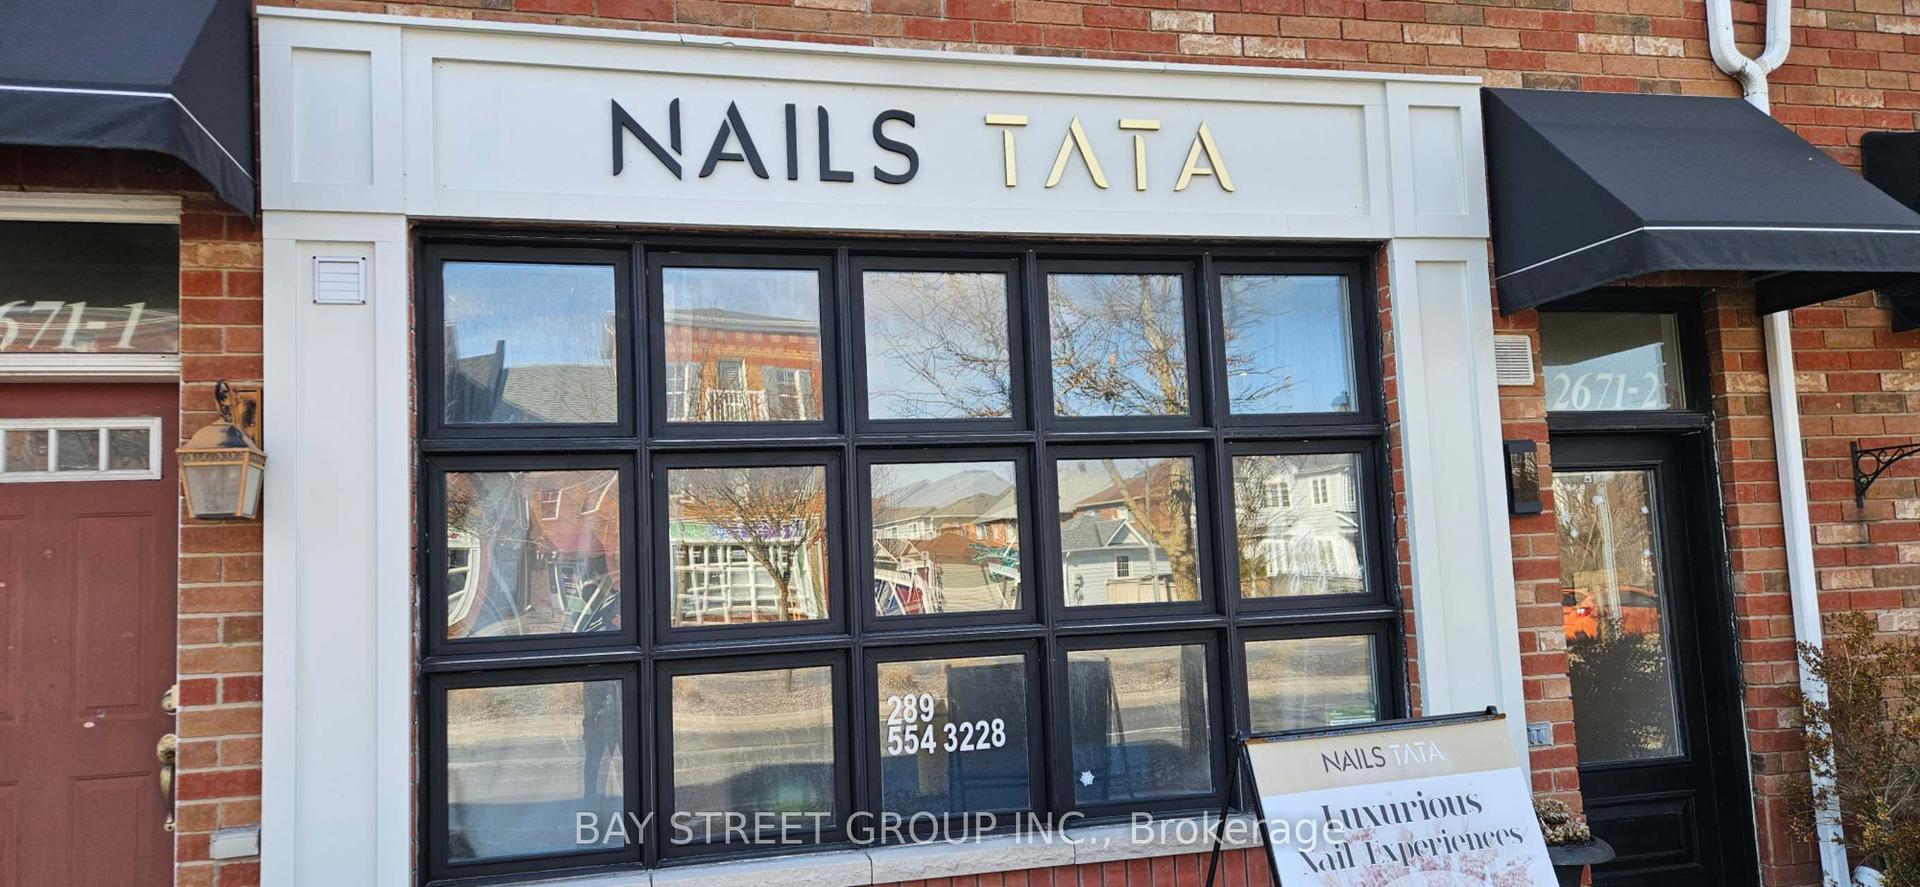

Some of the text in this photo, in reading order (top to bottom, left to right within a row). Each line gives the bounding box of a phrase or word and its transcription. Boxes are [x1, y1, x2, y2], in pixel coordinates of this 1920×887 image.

[611, 97, 1235, 193] NAILS TATA
[1552, 371, 1660, 411] 2671-2
[886, 693, 935, 726] 289
[887, 718, 1006, 756] 554 3228
[1320, 740, 1448, 773] NAILS TATA
[1320, 791, 1483, 832] Luxurious
[1299, 827, 1524, 875] Nail Experiences
